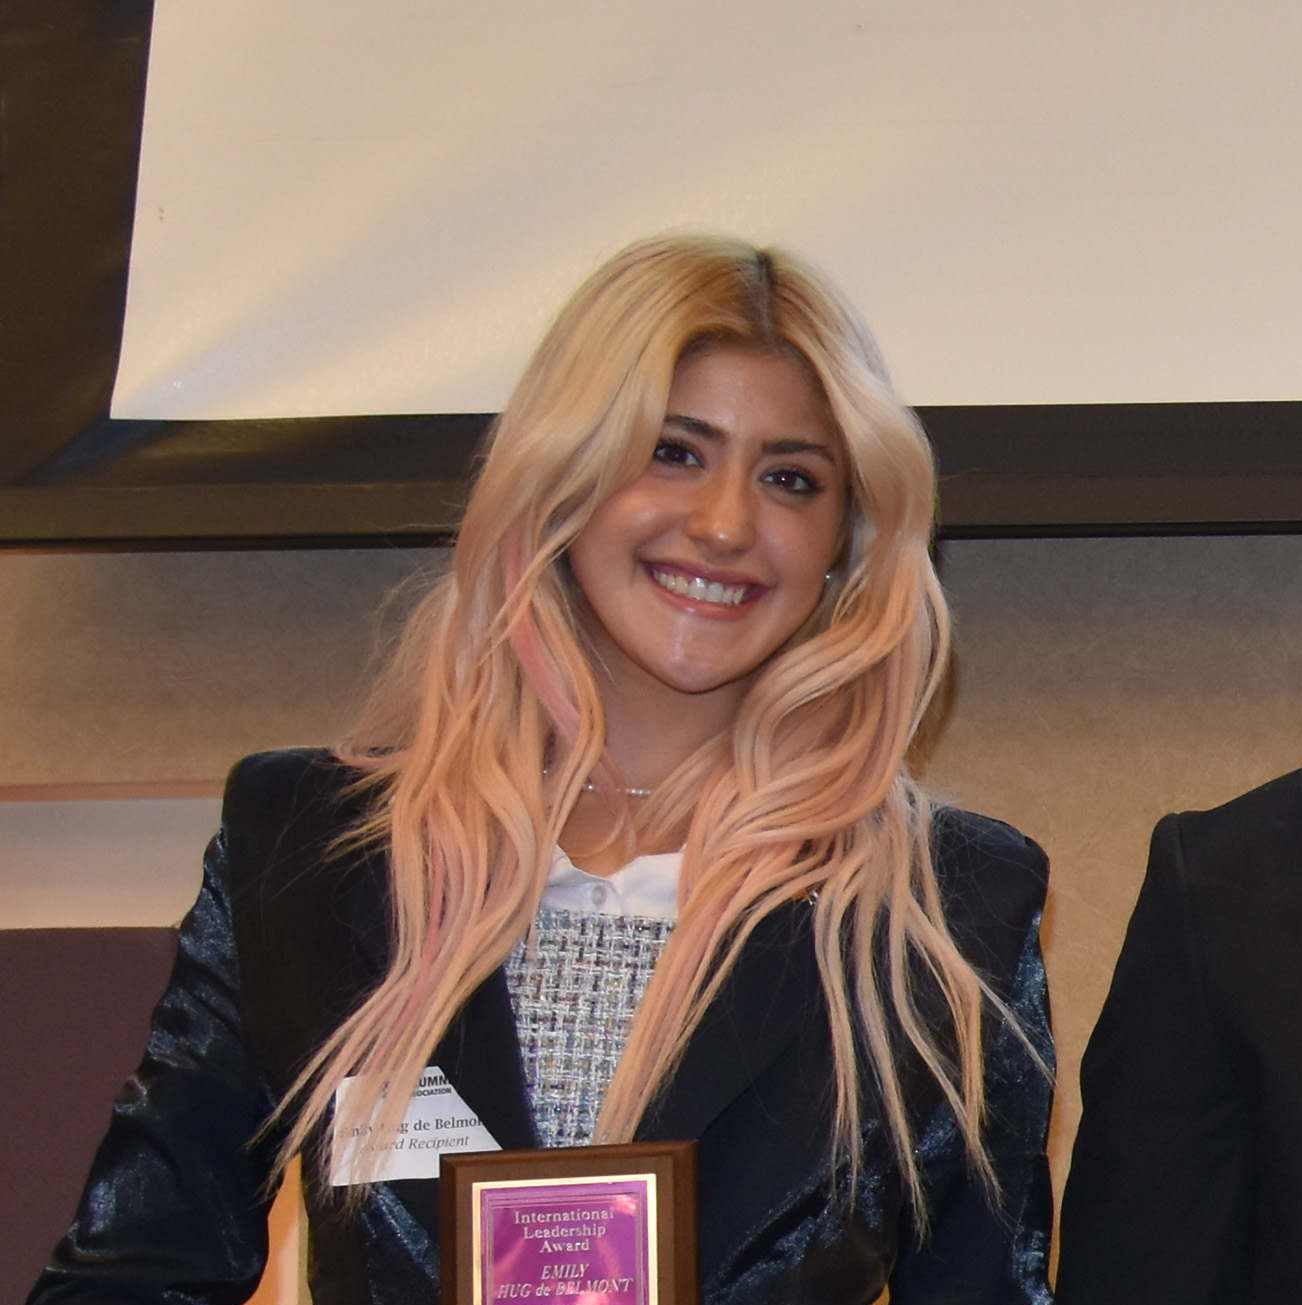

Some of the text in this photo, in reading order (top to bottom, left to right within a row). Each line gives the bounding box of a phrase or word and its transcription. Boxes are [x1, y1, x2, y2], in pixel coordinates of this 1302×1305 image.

[413, 1119, 431, 1131] de
[408, 1135, 469, 1150] Recipient
[514, 1207, 615, 1224] International
[523, 1223, 606, 1239] Leadership
[539, 1238, 590, 1253] Award
[541, 1263, 589, 1280] EMILY
[497, 1278, 634, 1299] HUG de BELMONT
